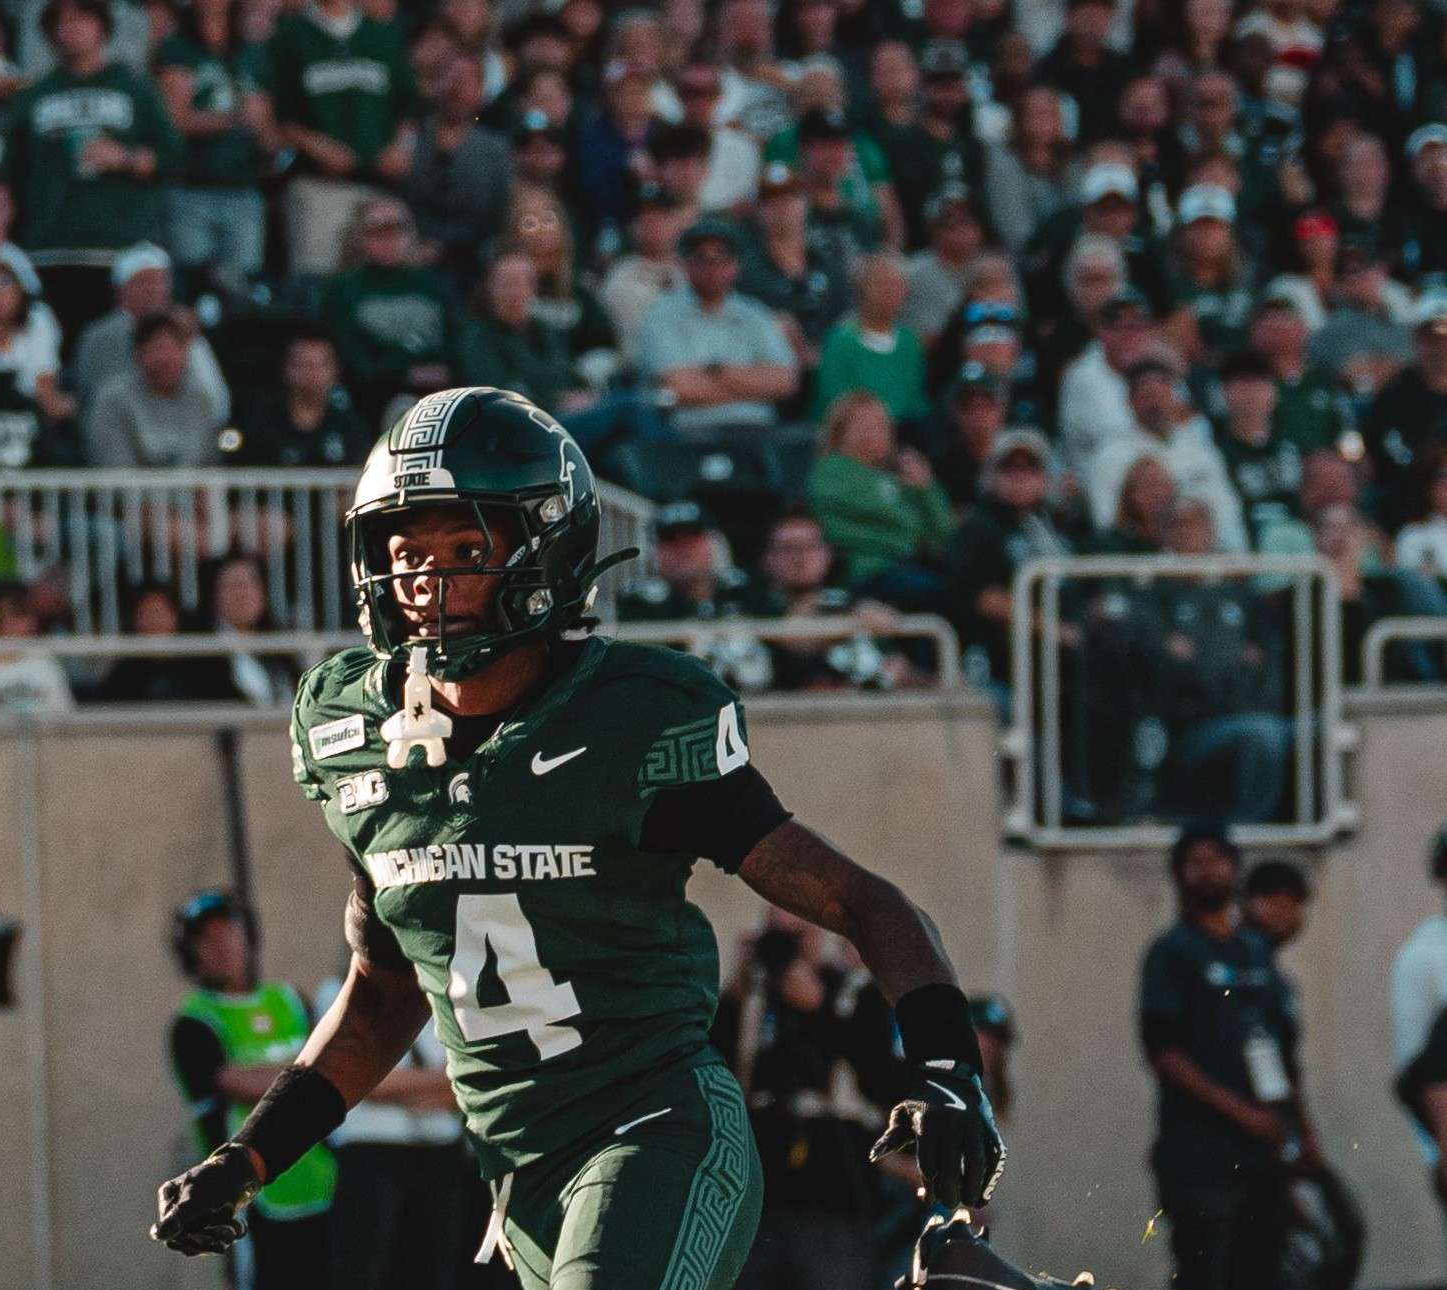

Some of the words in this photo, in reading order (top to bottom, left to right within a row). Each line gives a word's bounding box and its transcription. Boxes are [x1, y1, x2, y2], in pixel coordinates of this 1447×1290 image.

[394, 472, 431, 489] STATE
[365, 844, 486, 888] MICHIGAN
[493, 844, 597, 880] STATE
[449, 893, 583, 1062] 4
